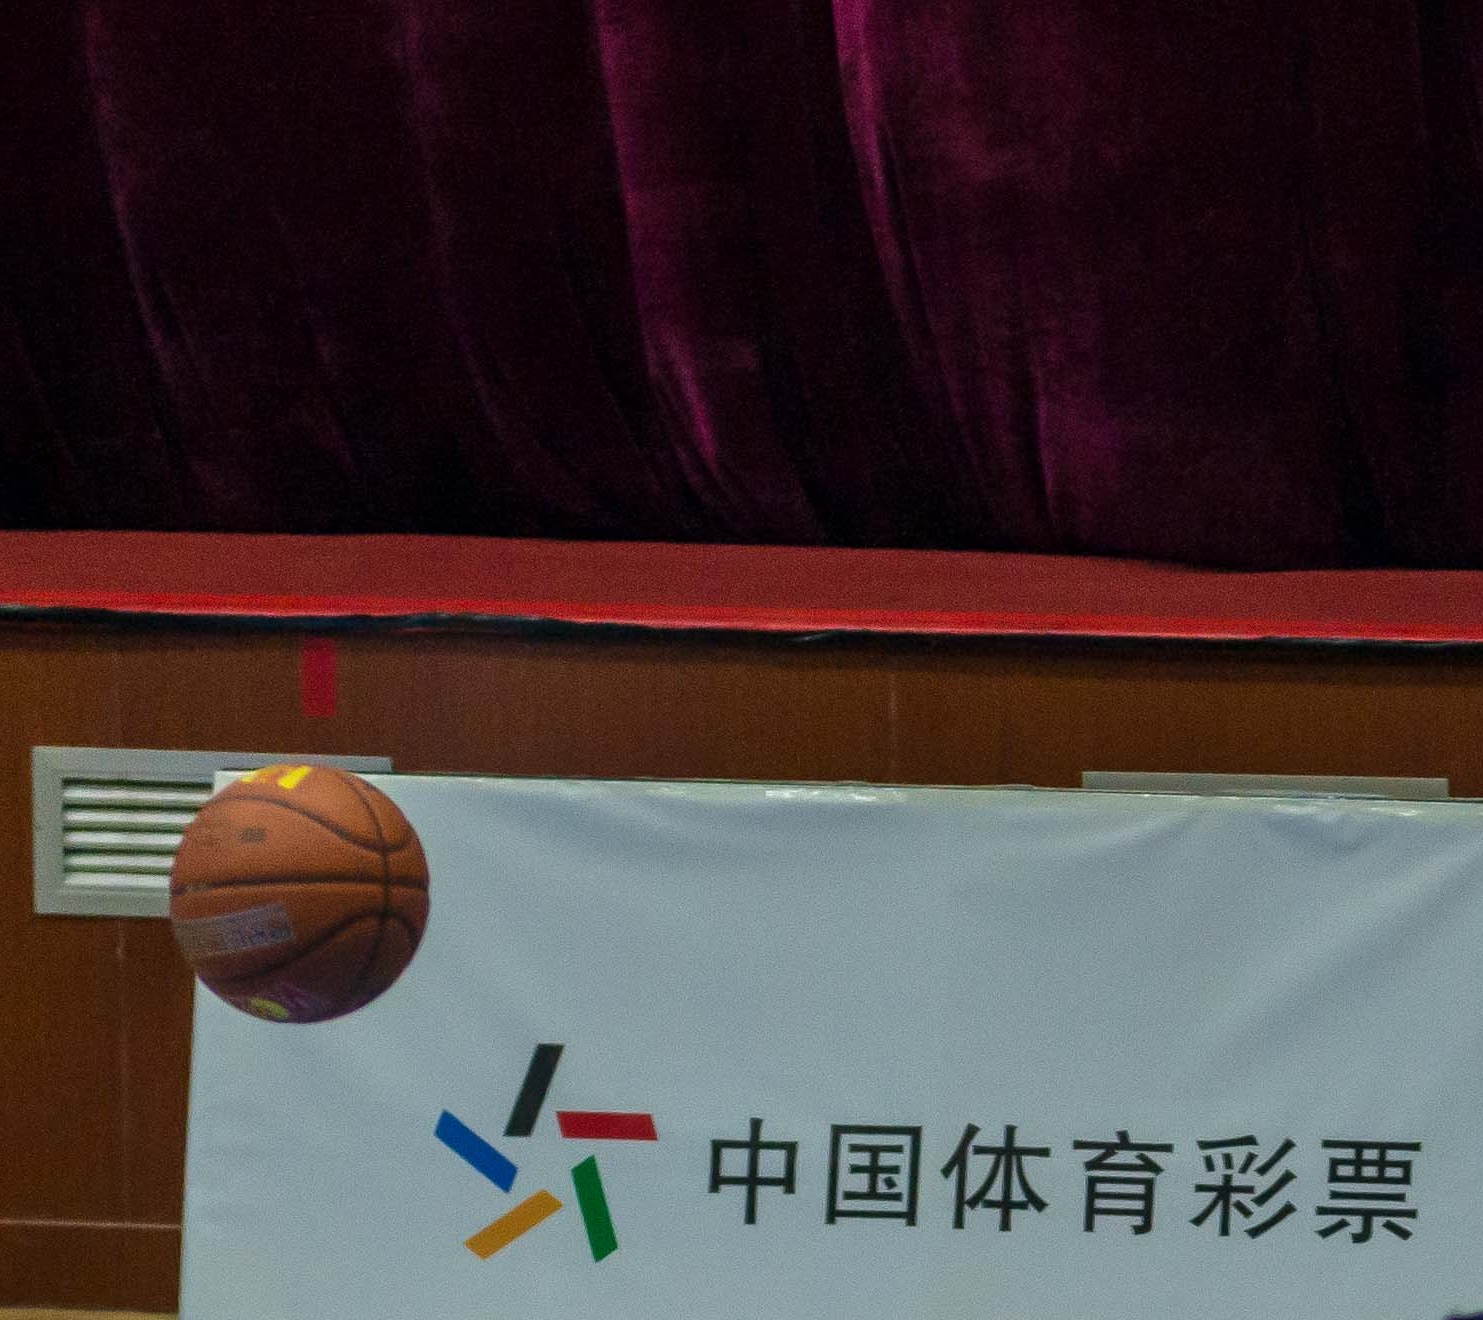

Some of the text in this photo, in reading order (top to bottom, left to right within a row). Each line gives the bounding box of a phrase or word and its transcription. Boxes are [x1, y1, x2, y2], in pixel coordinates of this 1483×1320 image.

[707, 1116, 1423, 1243] 中国体育彩票
